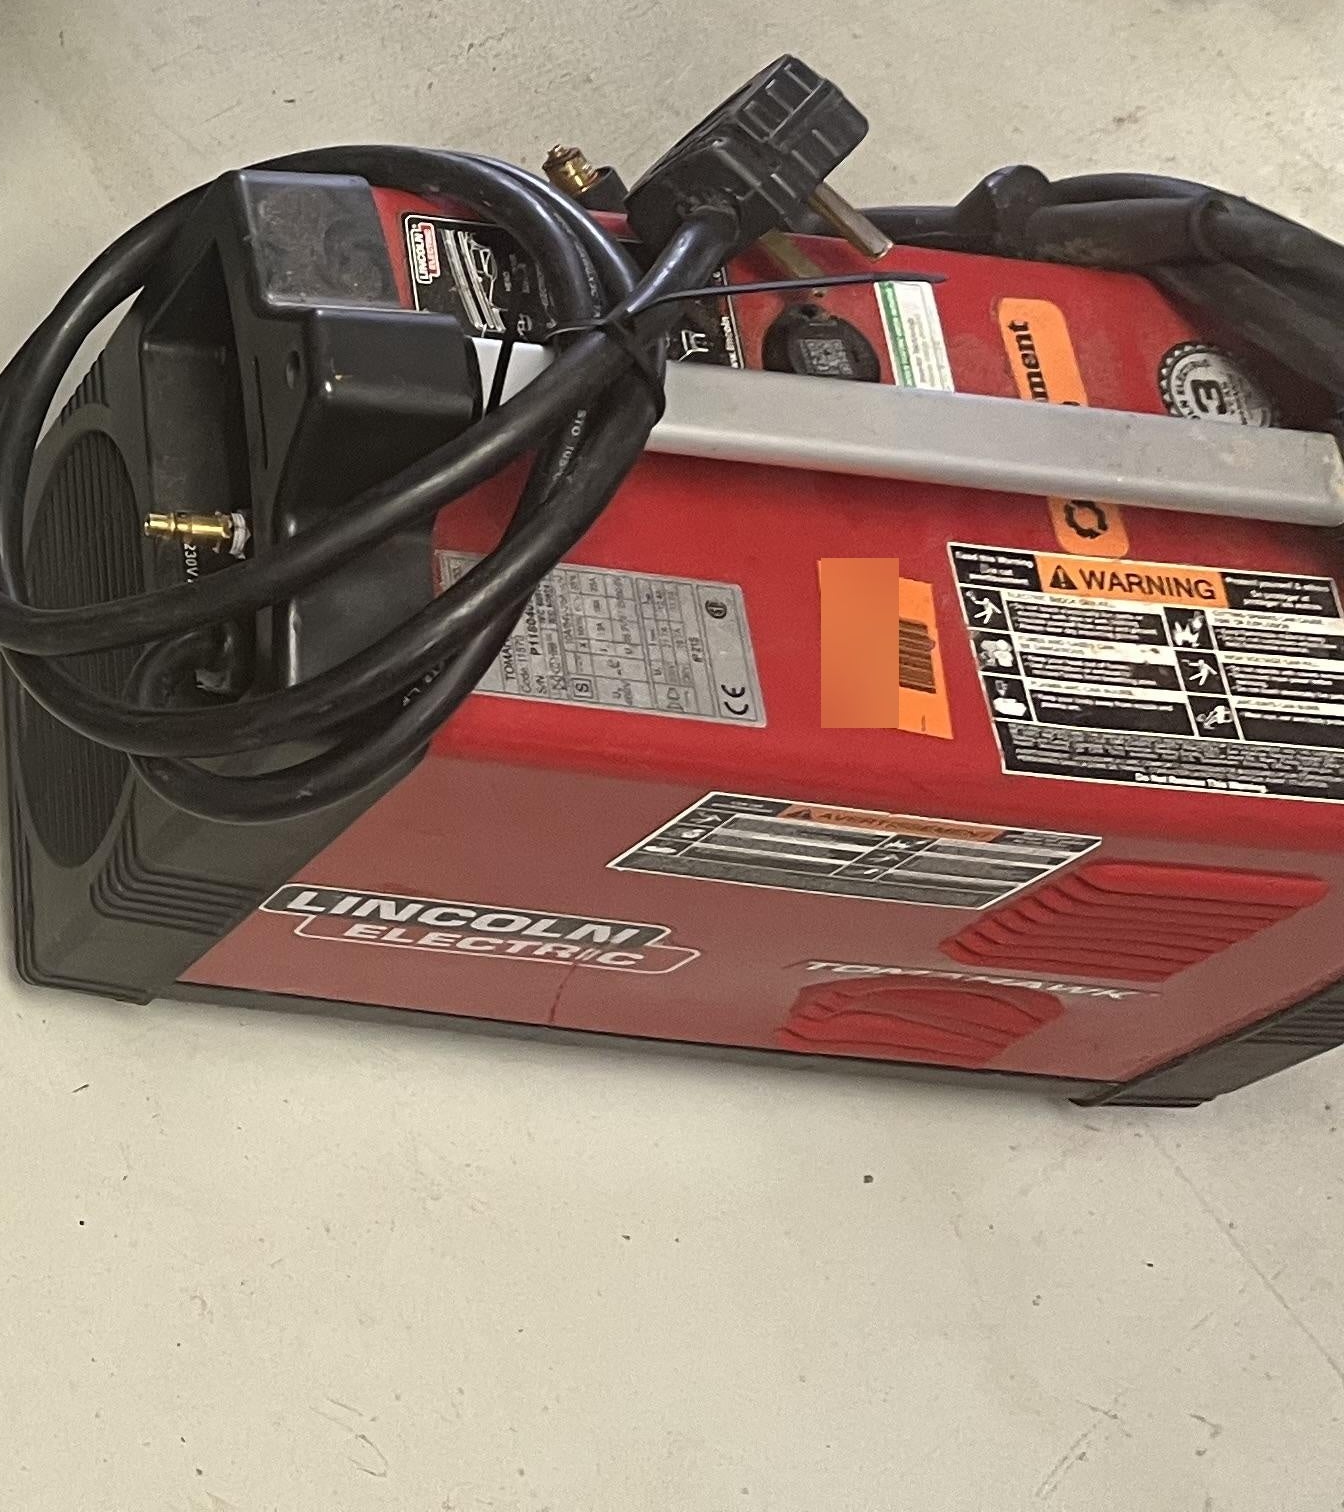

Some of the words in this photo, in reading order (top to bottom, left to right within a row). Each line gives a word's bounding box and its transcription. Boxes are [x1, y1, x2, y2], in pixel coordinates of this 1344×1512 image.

[414, 232, 428, 279] LINCOLN
[1006, 316, 1049, 406] ment
[1078, 568, 1217, 600] WARNING
[816, 807, 997, 843] AVERTISSEMENT
[288, 889, 639, 947] LINCOLN
[343, 922, 647, 968] ELECTRIC
[806, 961, 1143, 1001] TOMAHAWK
